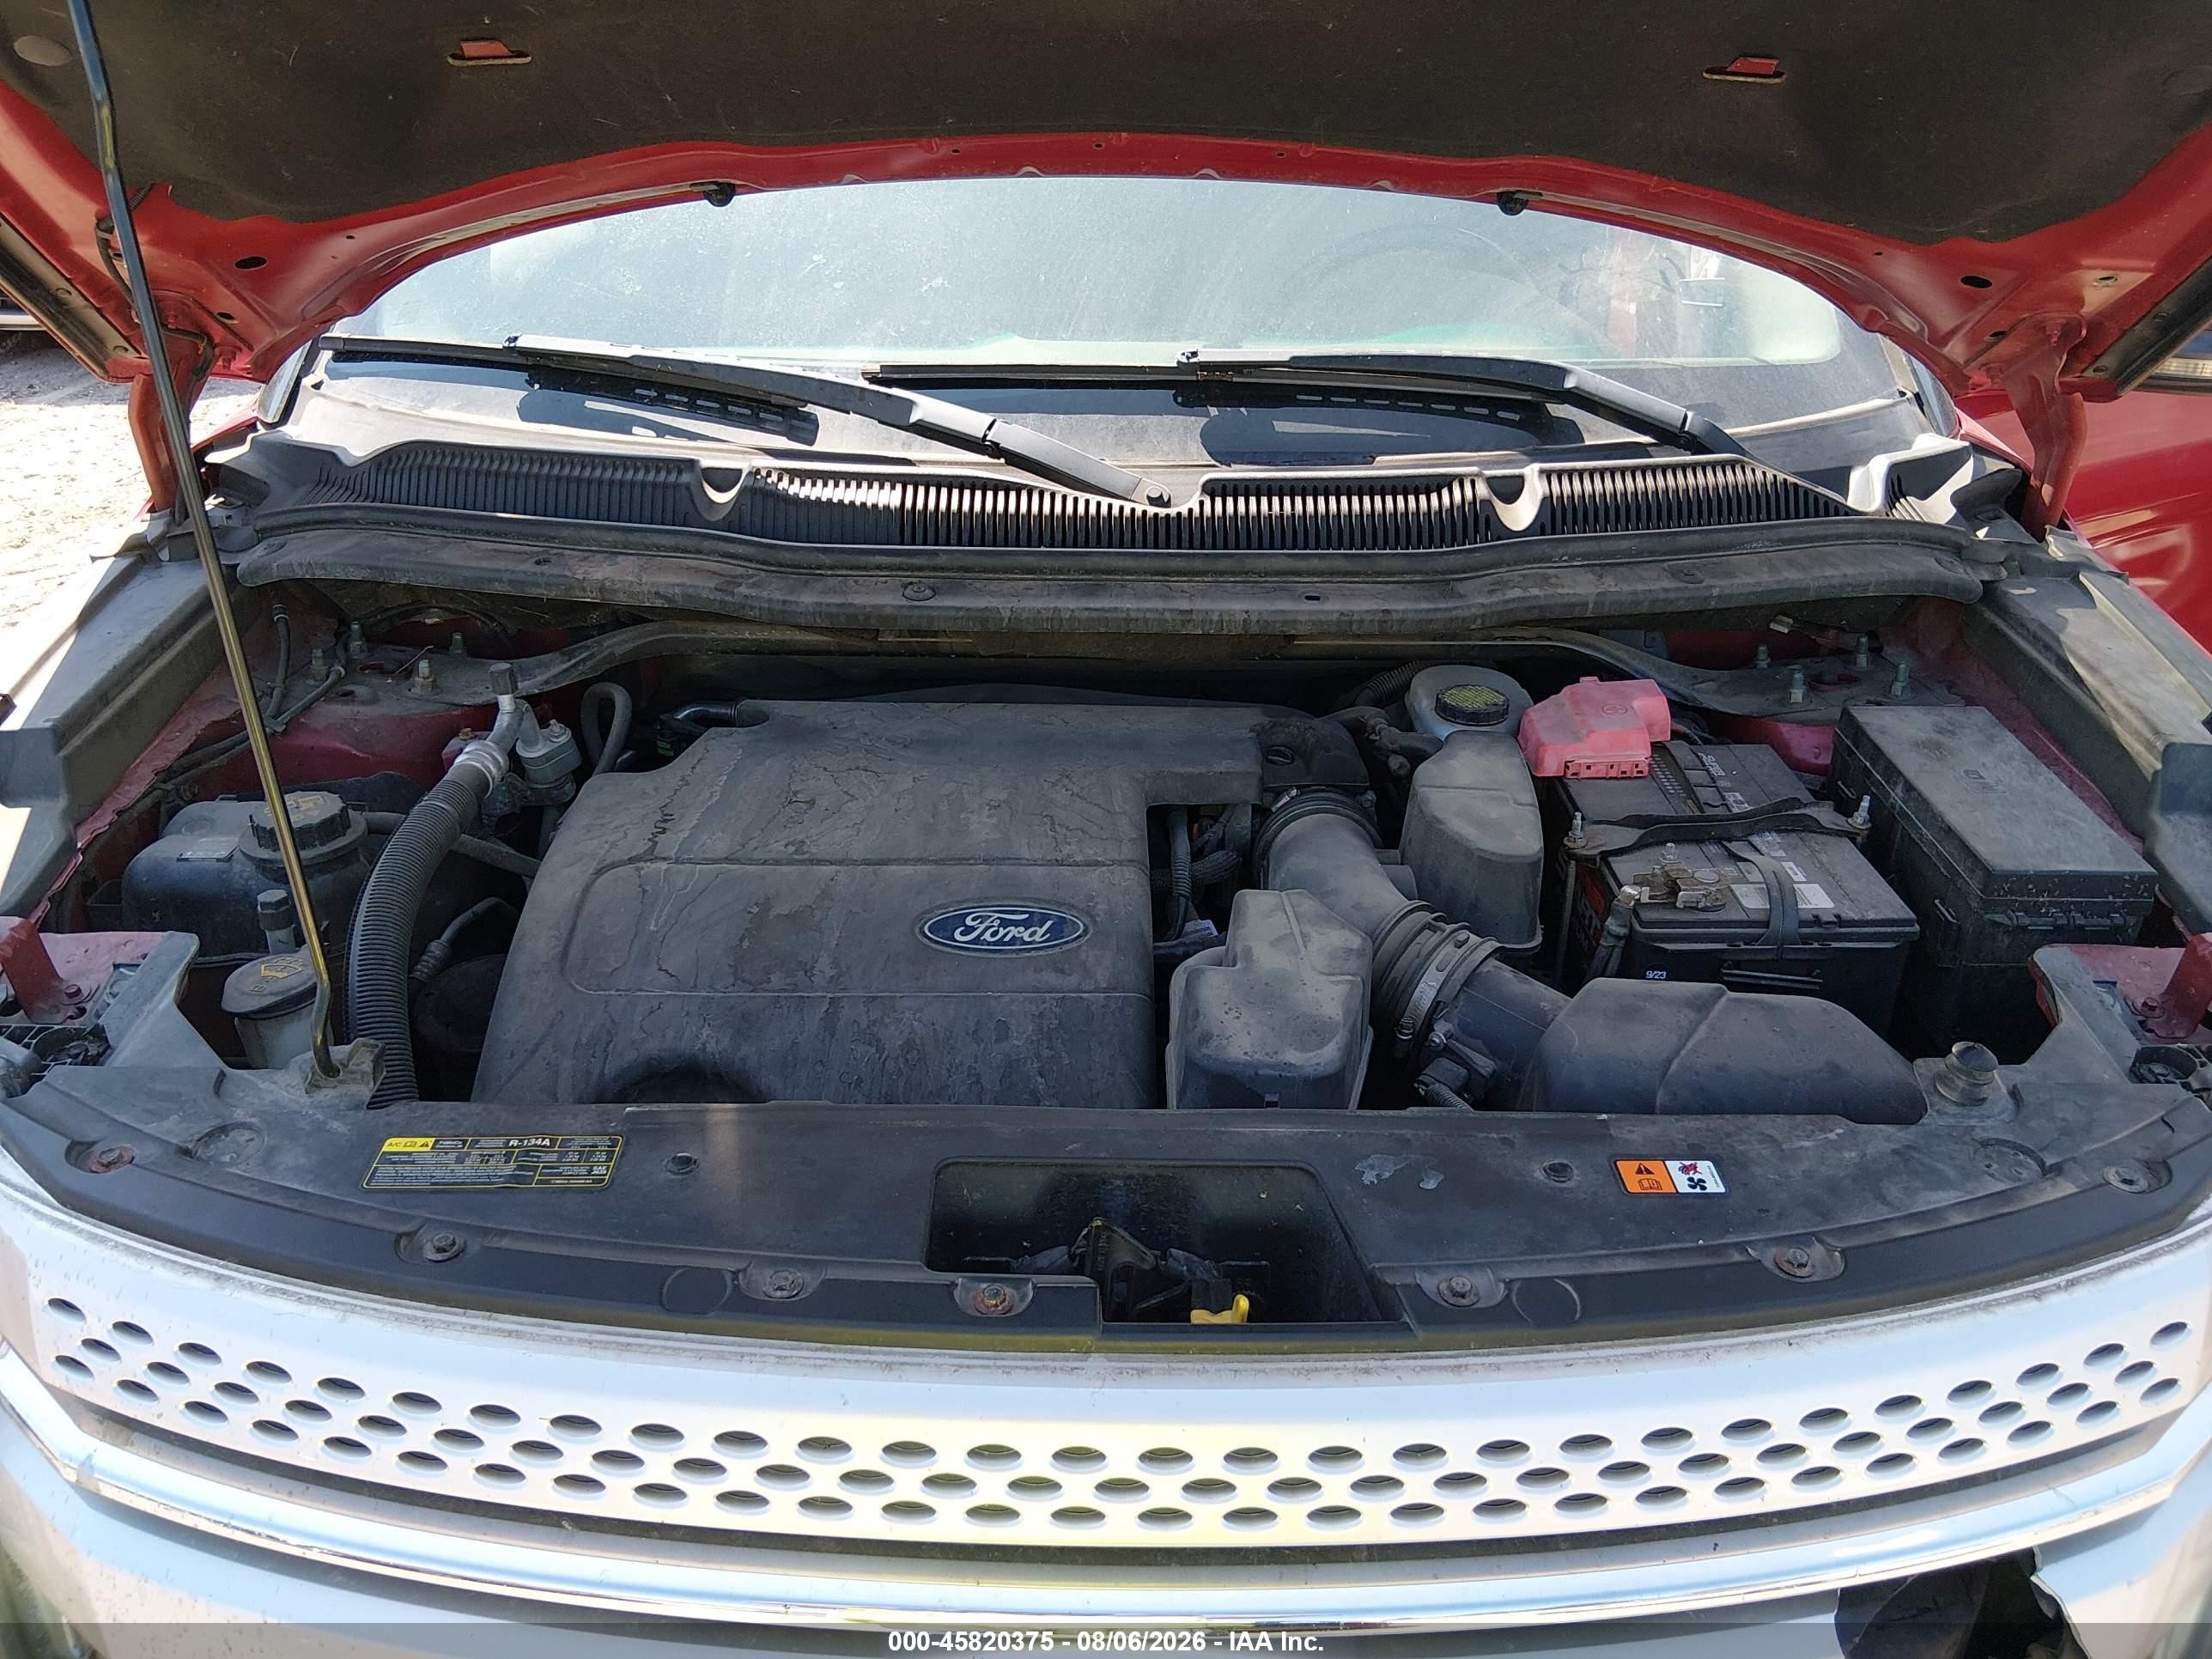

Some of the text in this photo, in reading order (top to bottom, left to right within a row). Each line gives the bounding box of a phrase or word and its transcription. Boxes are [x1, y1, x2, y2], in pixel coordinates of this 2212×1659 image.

[953, 912, 1054, 942] Ford
[1645, 970, 1667, 979] 9/23
[508, 1138, 550, 1146] R-134A
